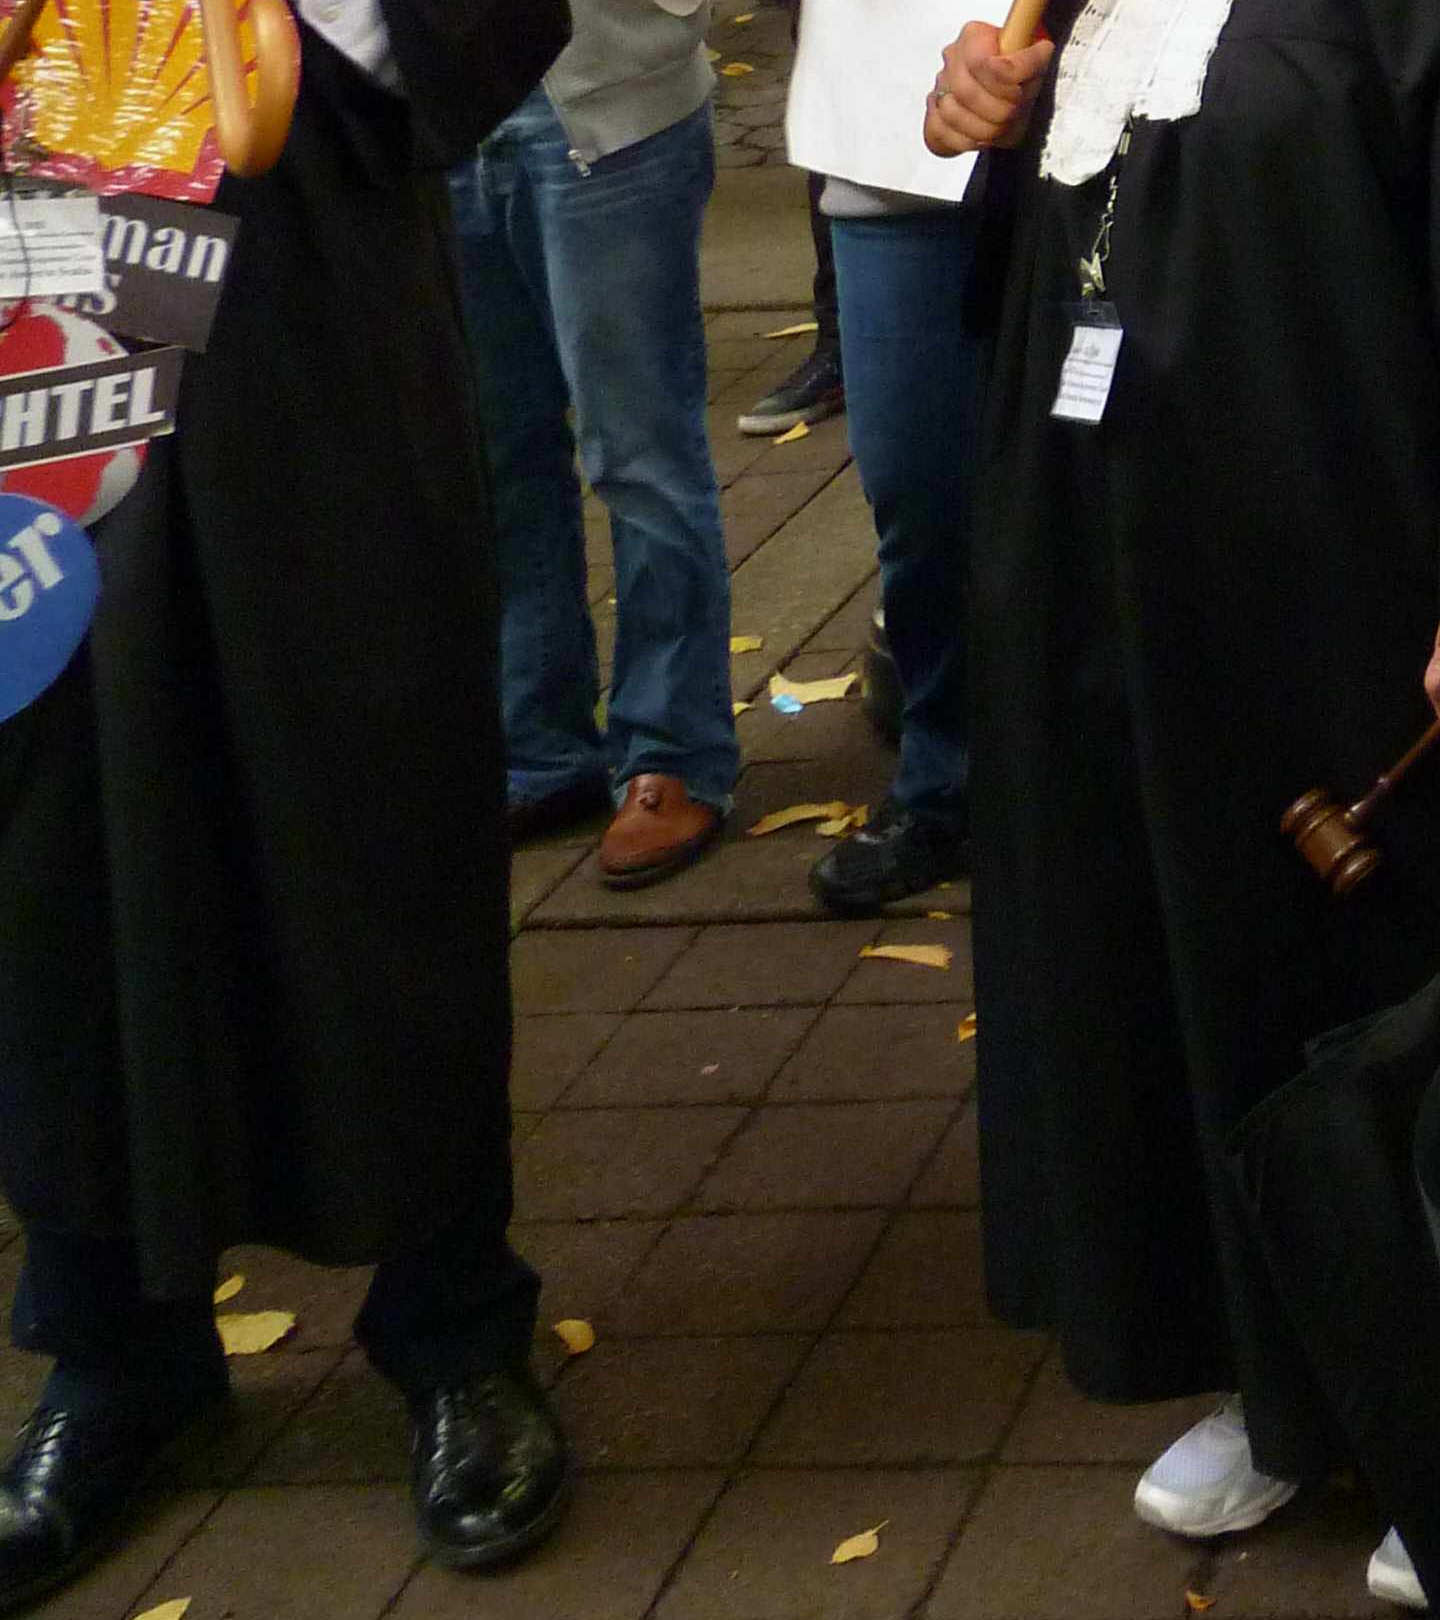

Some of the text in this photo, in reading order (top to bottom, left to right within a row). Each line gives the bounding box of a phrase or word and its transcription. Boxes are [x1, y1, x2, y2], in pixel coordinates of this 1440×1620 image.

[100, 211, 228, 283] man
[0, 366, 166, 451] HTEL
[0, 512, 64, 620] er
